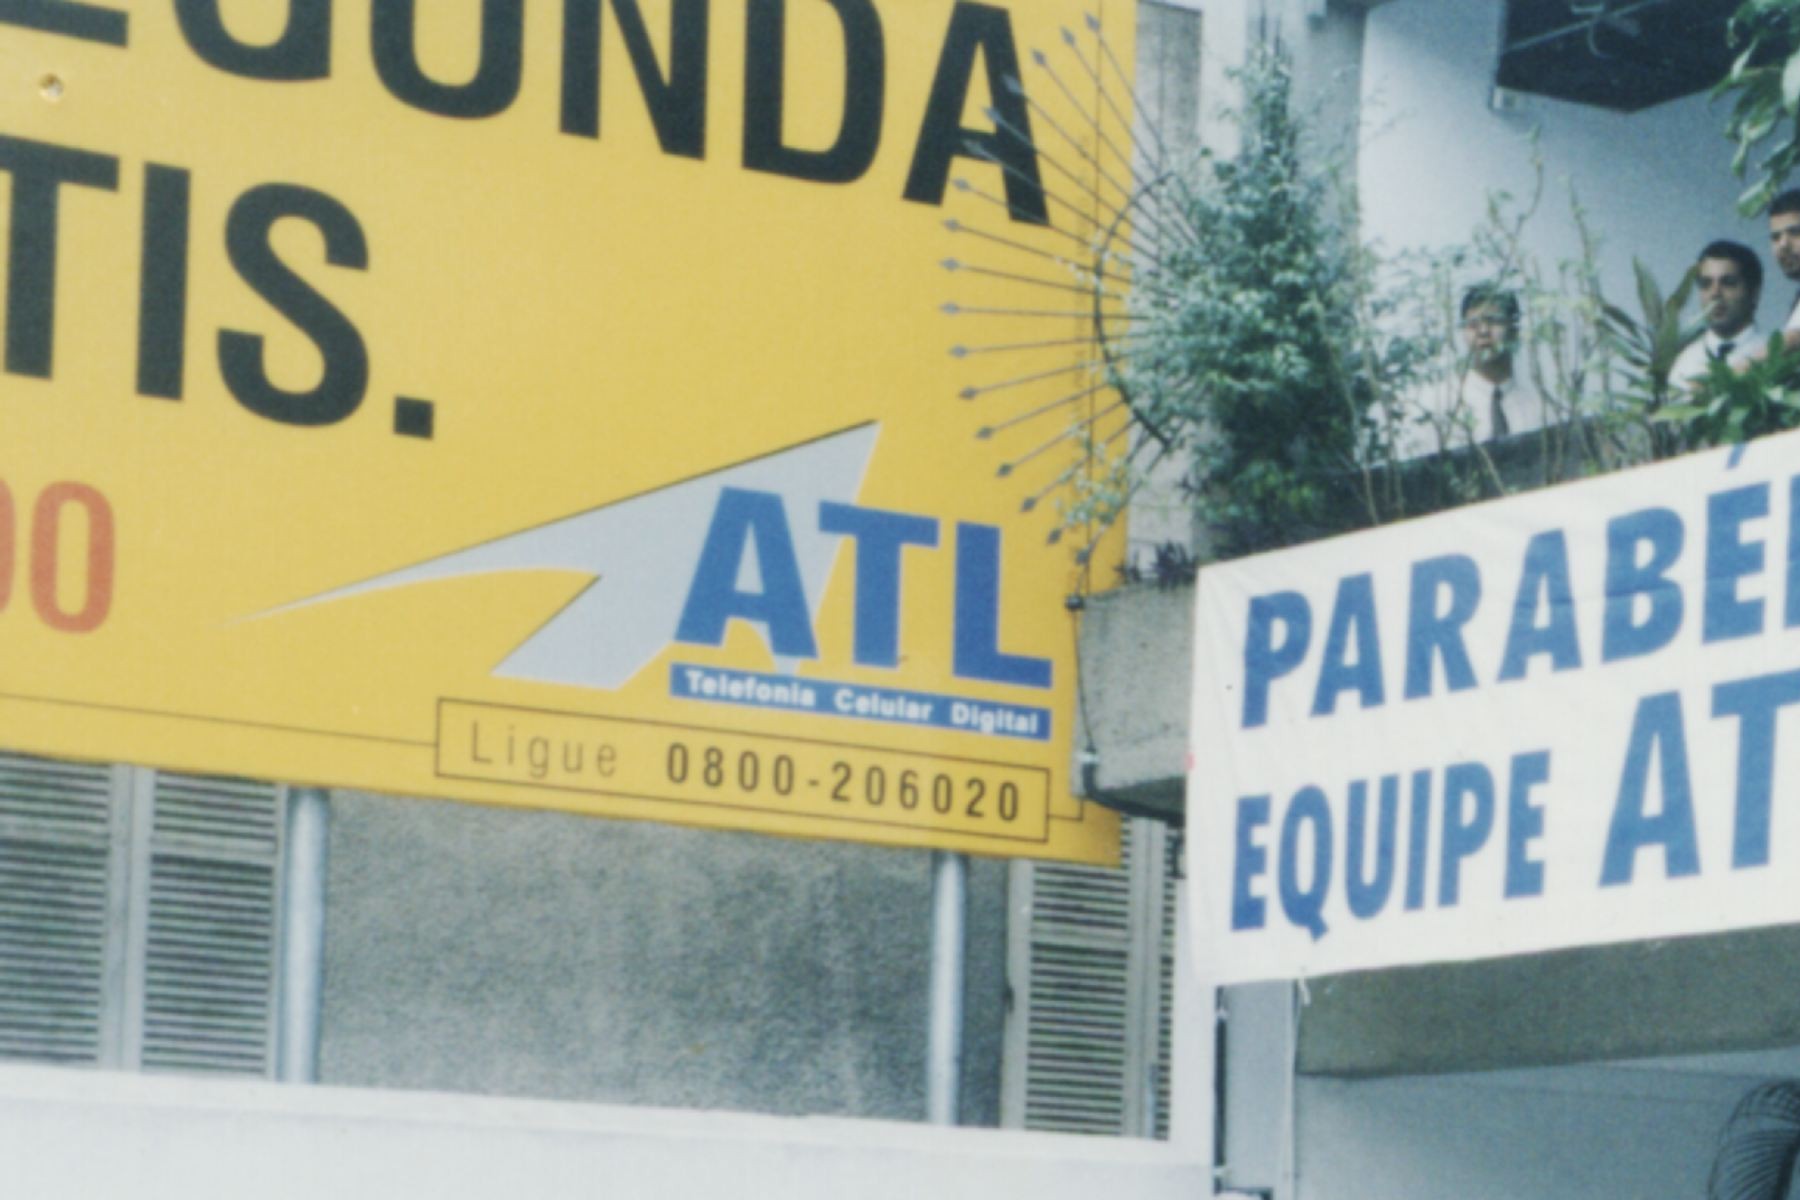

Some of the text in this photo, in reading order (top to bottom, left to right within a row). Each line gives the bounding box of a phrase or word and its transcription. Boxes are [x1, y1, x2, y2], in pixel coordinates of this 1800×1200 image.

[0, 0, 1050, 227] UNDA
[0, 476, 116, 634] 0
[674, 485, 1053, 689] ATL
[470, 719, 1020, 823] Ligue 0800-206020
[685, 668, 1040, 735] Telefonia Celular Digital
[1231, 749, 1551, 942] EQUIPE
